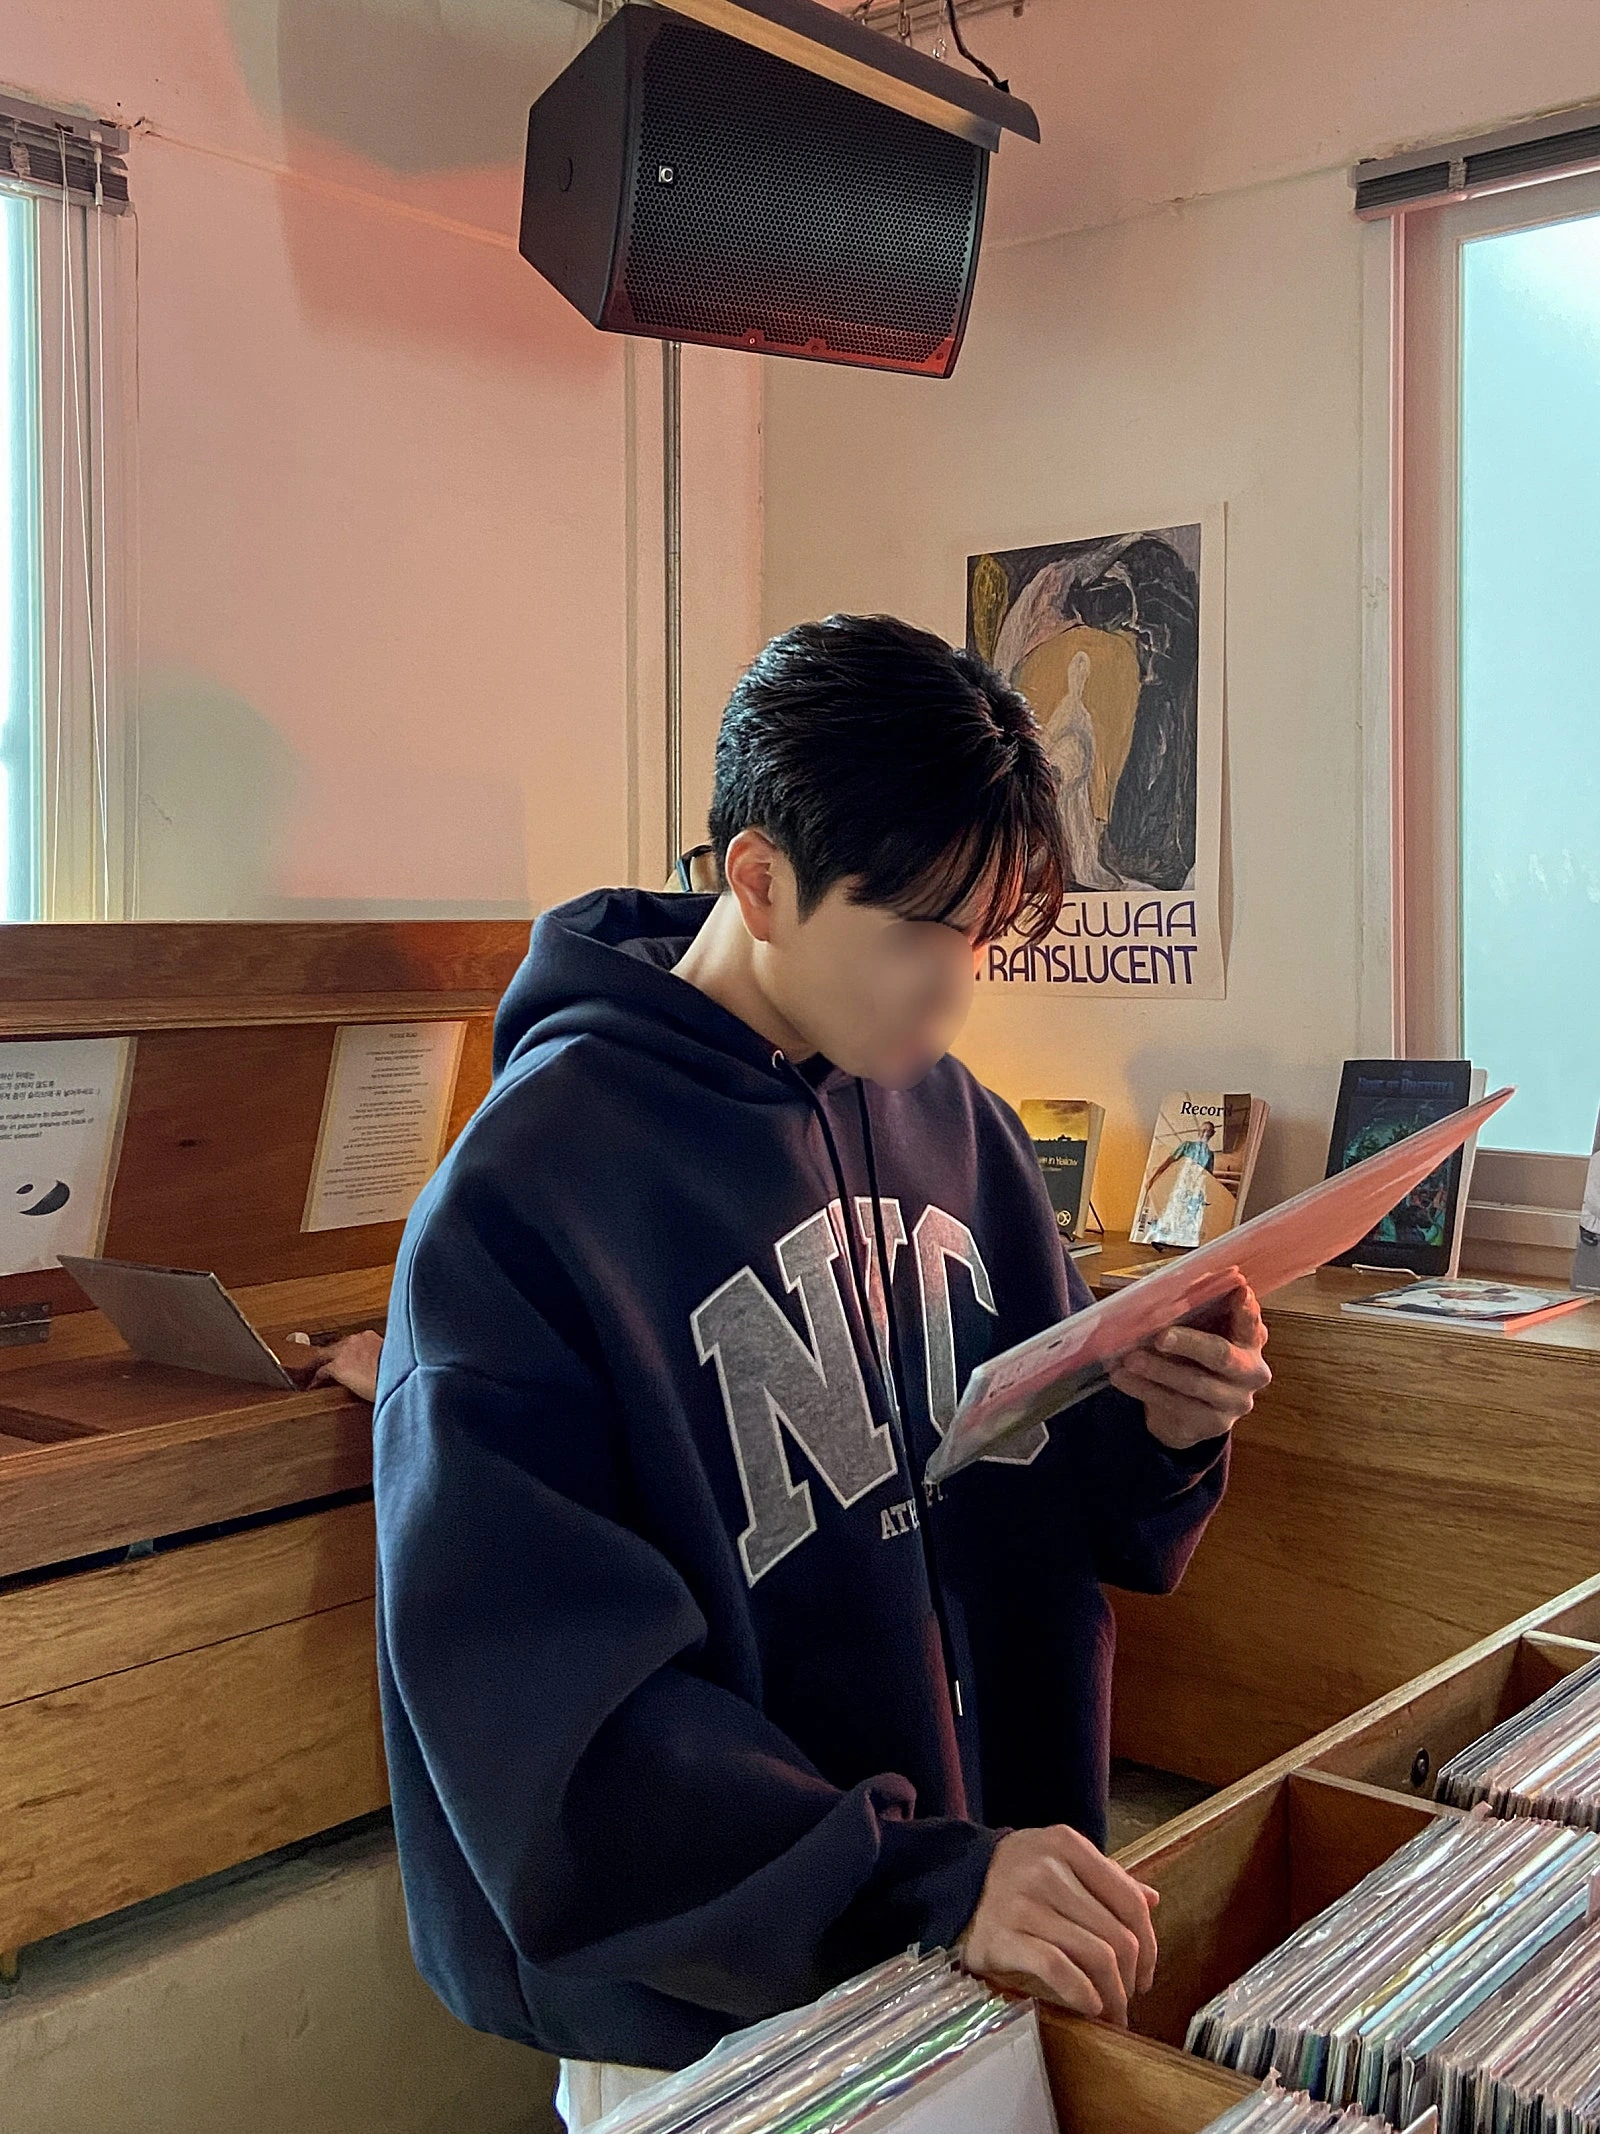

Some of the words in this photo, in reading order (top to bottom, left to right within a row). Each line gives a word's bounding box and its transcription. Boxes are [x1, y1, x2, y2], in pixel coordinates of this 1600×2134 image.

[1003, 901, 1197, 938] OGWAA
[975, 945, 1198, 985] RANSLUCENT
[1180, 1101, 1234, 1118] Record
